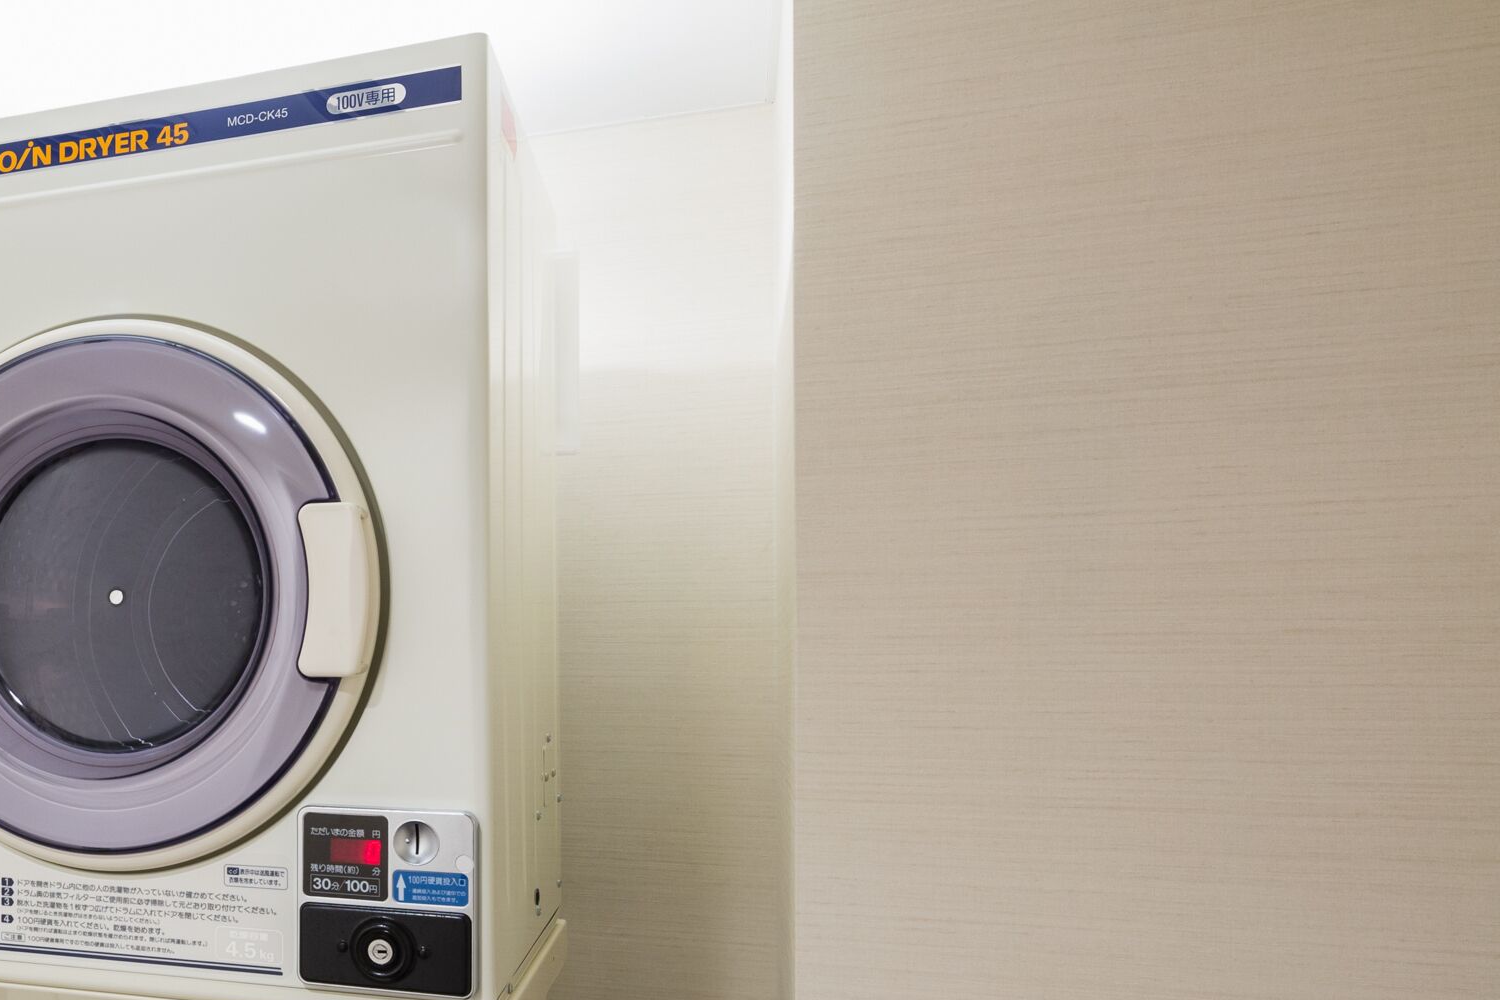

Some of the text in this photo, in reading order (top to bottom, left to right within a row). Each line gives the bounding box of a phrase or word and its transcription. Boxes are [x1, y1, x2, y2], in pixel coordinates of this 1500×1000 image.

[336, 87, 396, 111] 100V専用
[227, 107, 289, 127] MCD-CK45
[58, 129, 150, 164] DRYER
[156, 122, 190, 147] 45
[310, 827, 381, 839] ただいまの金額 円
[371, 867, 381, 877] 分
